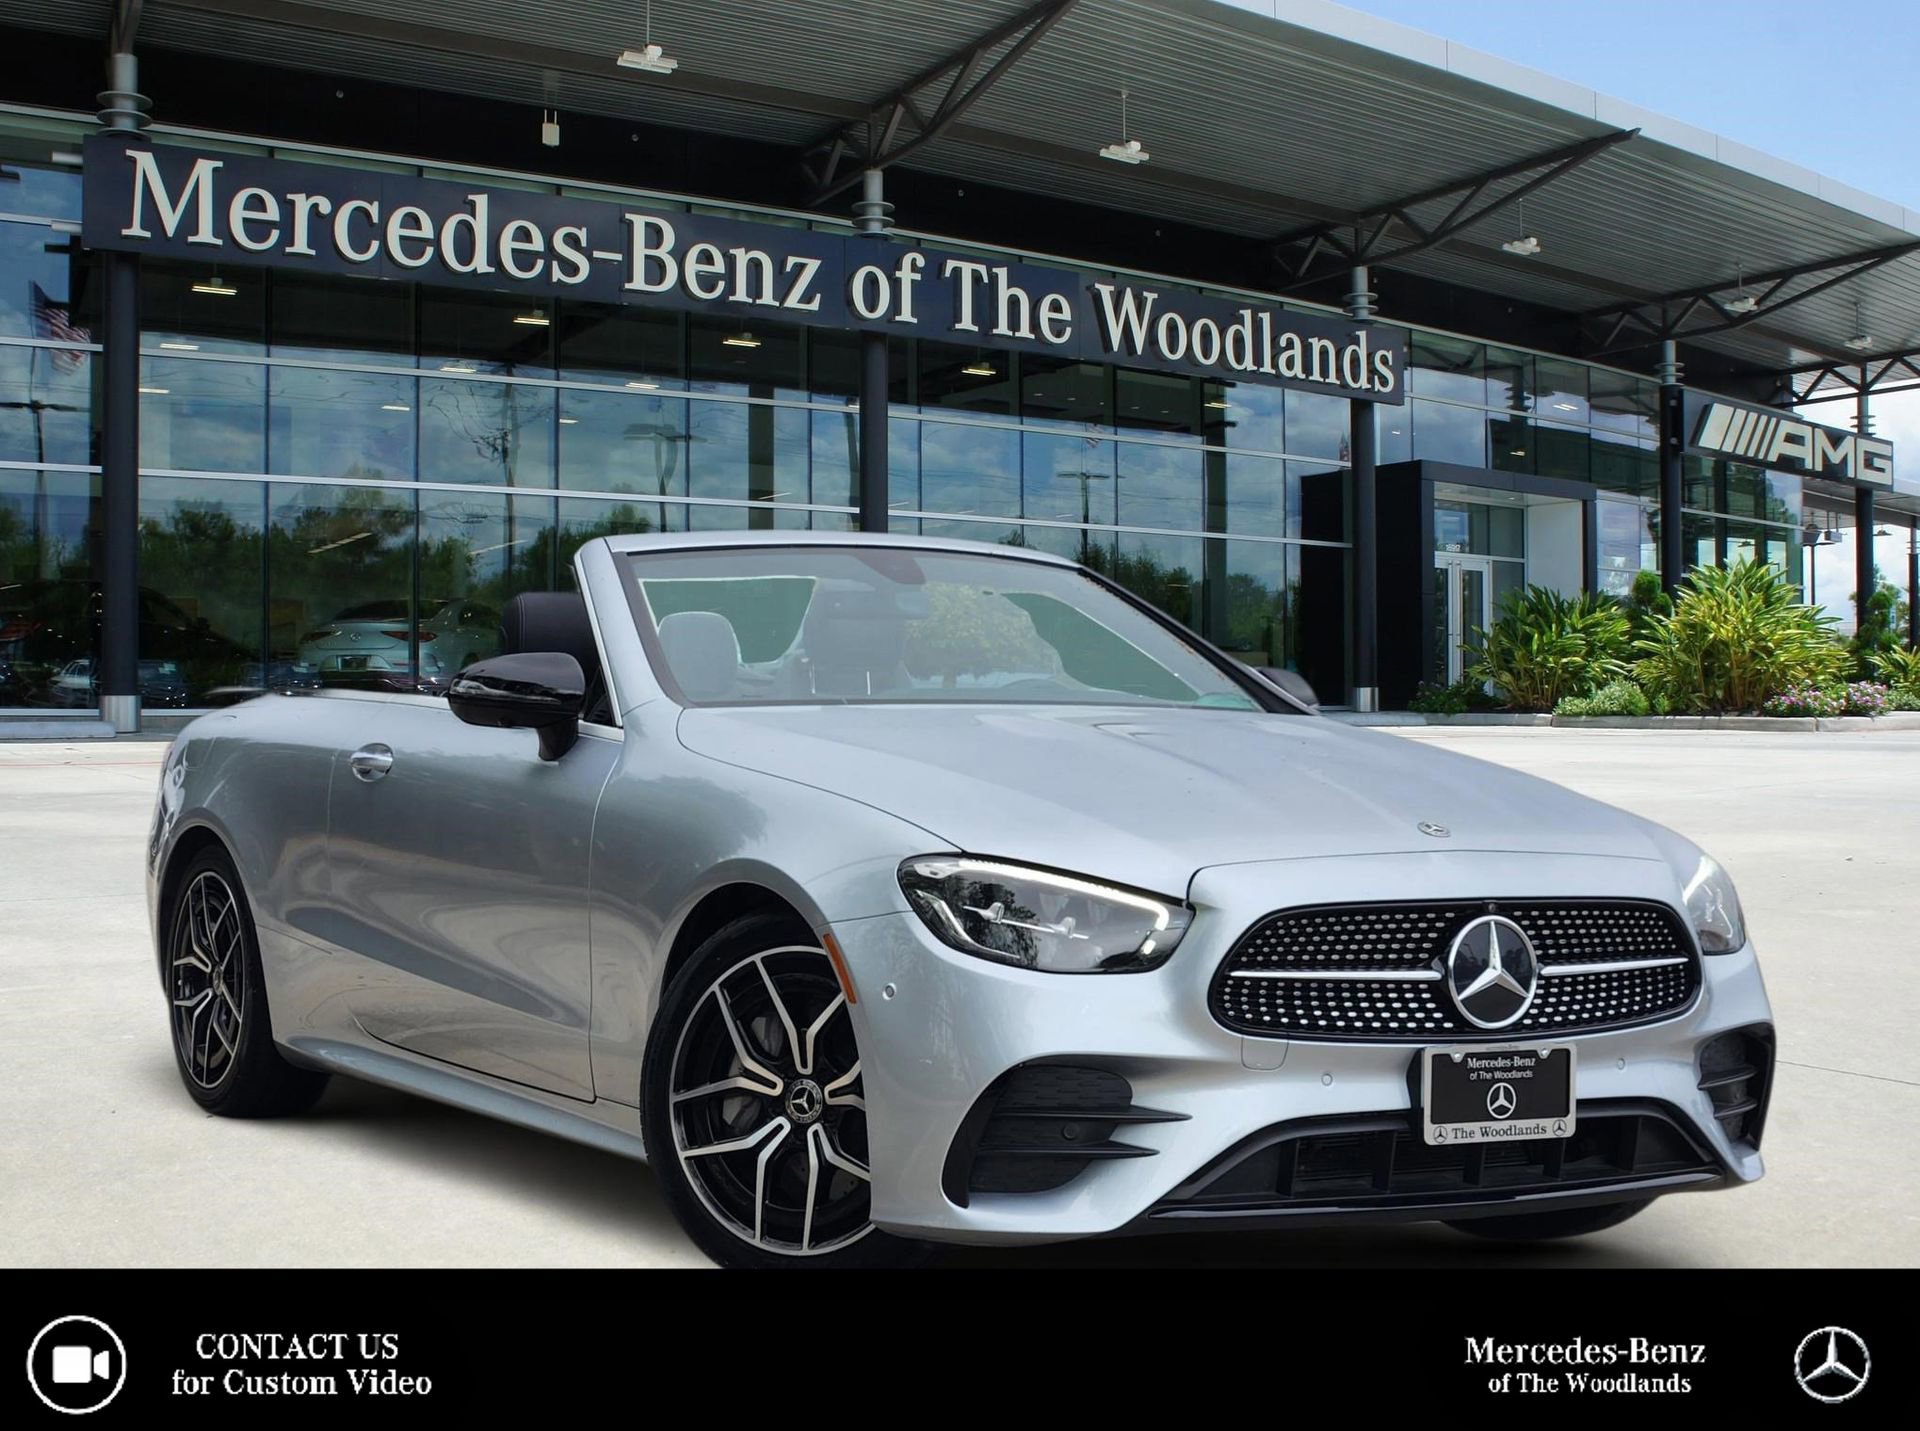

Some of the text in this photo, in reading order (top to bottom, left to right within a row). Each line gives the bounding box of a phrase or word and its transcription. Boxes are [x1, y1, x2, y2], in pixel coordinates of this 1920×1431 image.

[121, 149, 1395, 393] Mercedes-Benz of The Woodlands
[1766, 418, 1894, 486] AMG
[1466, 1056, 1536, 1069] Mercedes-Benz
[1469, 1069, 1534, 1081] of The Woodlands
[1451, 1123, 1548, 1140] The Woodlands
